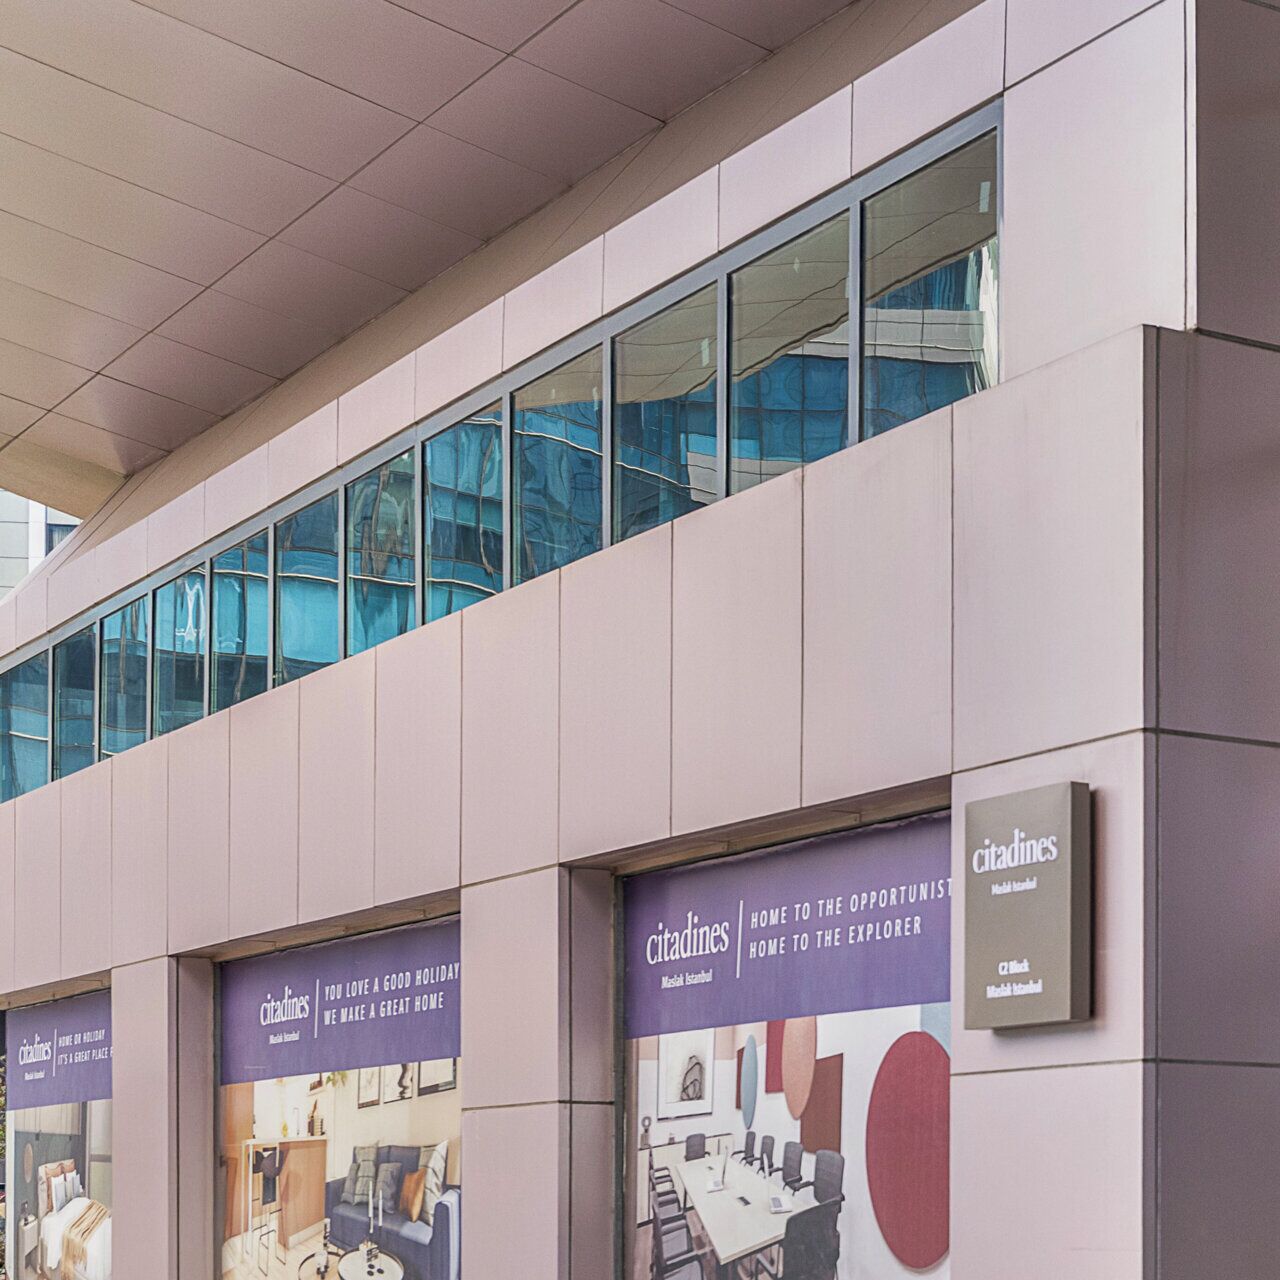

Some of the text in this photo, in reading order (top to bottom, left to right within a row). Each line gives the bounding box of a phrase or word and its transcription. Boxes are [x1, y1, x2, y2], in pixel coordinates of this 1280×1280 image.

[972, 828, 1058, 874] citadines
[751, 906, 787, 929] HOME
[794, 902, 810, 921] TO
[818, 897, 842, 918] THE
[646, 911, 730, 965] citadines
[749, 916, 922, 959] HOME TO THE EXPLORER
[325, 962, 460, 1001] YOU LOVE A GOOD HOLIDAY
[662, 969, 713, 989] Maslak Istanbul
[259, 985, 310, 1026] citadines
[324, 991, 444, 1026] WE MAKE A GREAT HOME
[18, 1033, 52, 1065] citadines
[59, 1029, 105, 1047] HOME OR HOLIDAY
[69, 1053, 73, 1063] A
[74, 1050, 90, 1063] GREAT
[91, 1047, 108, 1060] PLACE
